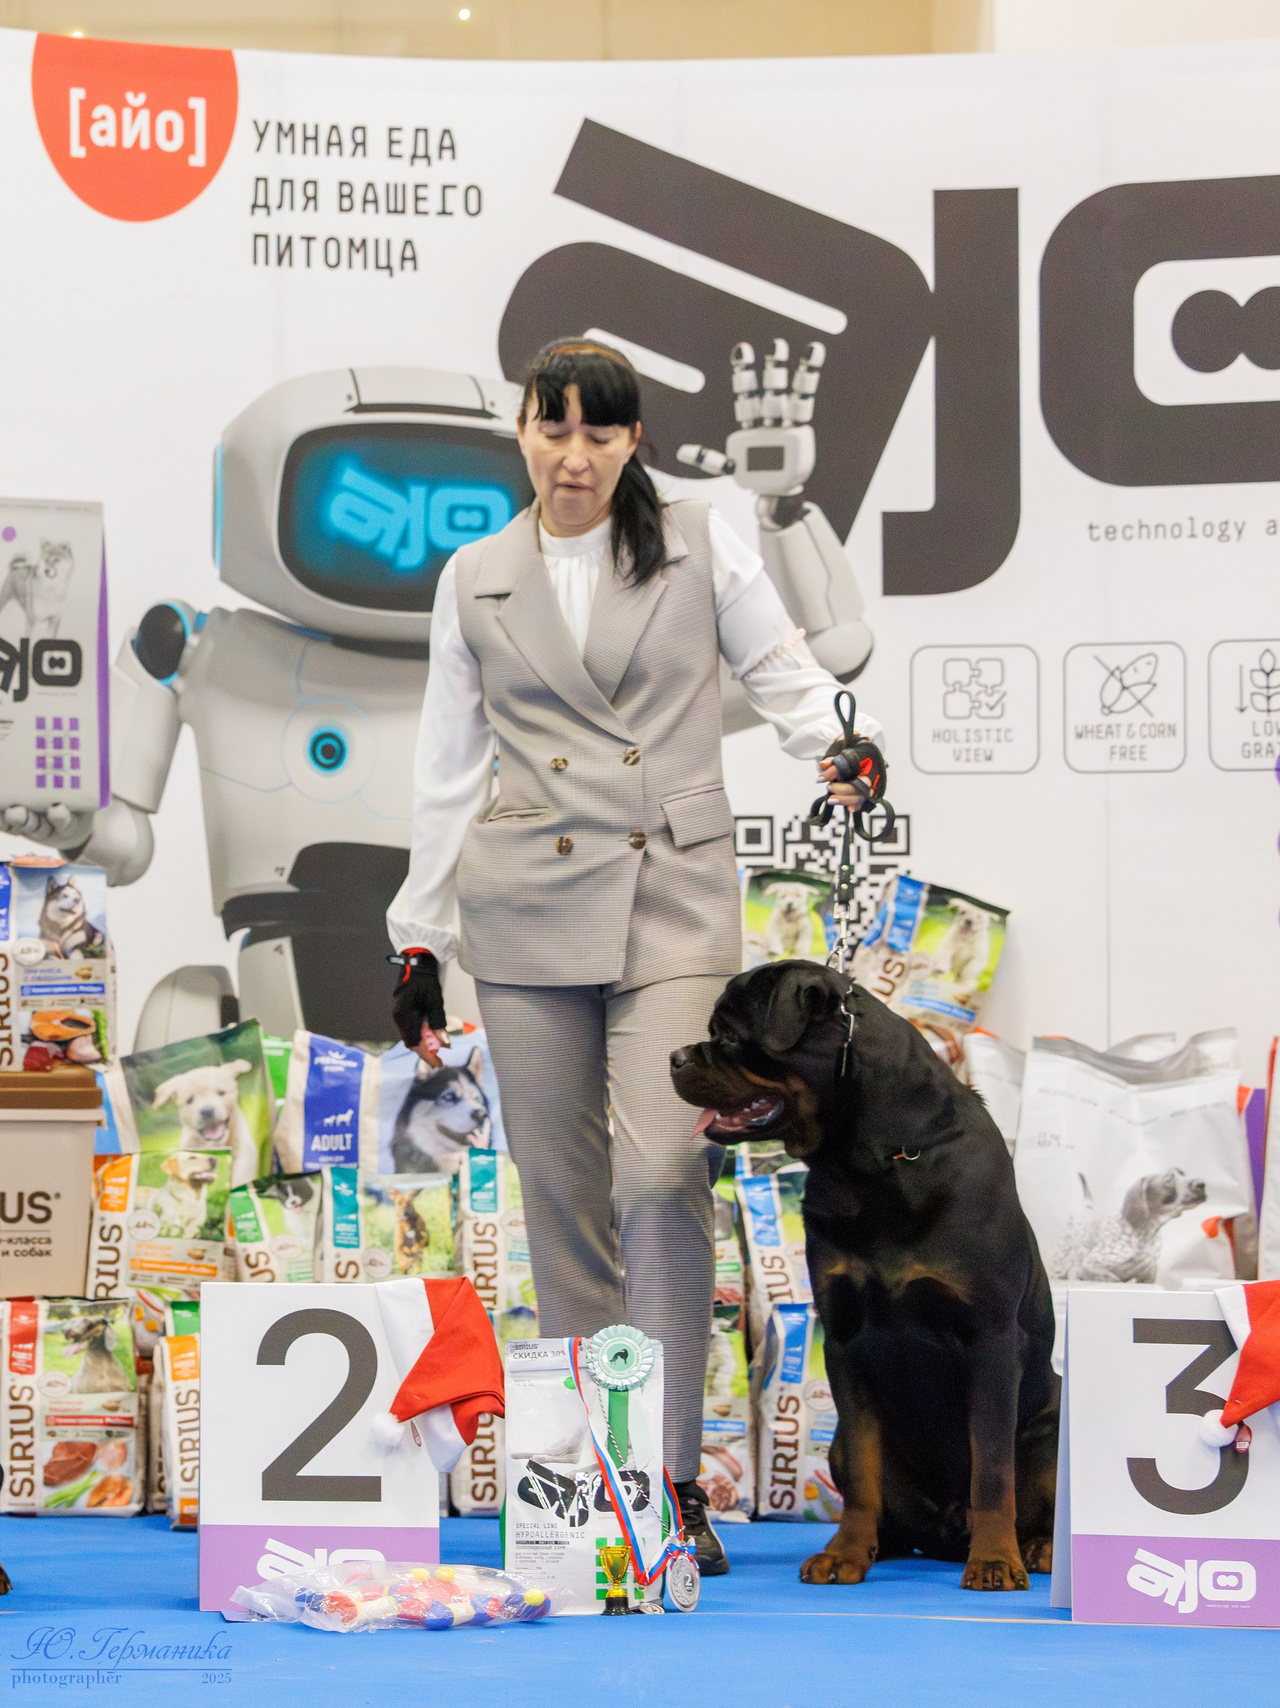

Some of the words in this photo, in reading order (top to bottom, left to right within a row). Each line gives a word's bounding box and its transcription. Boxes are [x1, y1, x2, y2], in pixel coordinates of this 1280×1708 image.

[252, 119, 367, 158] УМНАЯ
[388, 127, 456, 166] ЕДА
[250, 177, 319, 216] ДЛЯ
[338, 181, 483, 216] ВАШЕГО
[252, 233, 417, 277] ПИТОМЦА
[1088, 517, 1246, 543] technology
[932, 728, 1013, 744] HOLISTIC
[1075, 724, 1123, 740] WHEAT
[1139, 723, 1177, 739] CORN
[953, 748, 994, 763] VIEW
[1109, 745, 1148, 761] FREE
[310, 1133, 353, 1152] ADULT
[14, 1249, 52, 1258] собак
[513, 1351, 549, 1359] СКИДКА
[256, 1308, 382, 1502] 2
[1126, 1317, 1250, 1516] 3
[9, 1385, 35, 1498] SIRIUS
[769, 1394, 801, 1511] SIRIUS
[515, 1531, 586, 1539] HYPOALLERGENIC
[685, 1573, 693, 1586] 2
